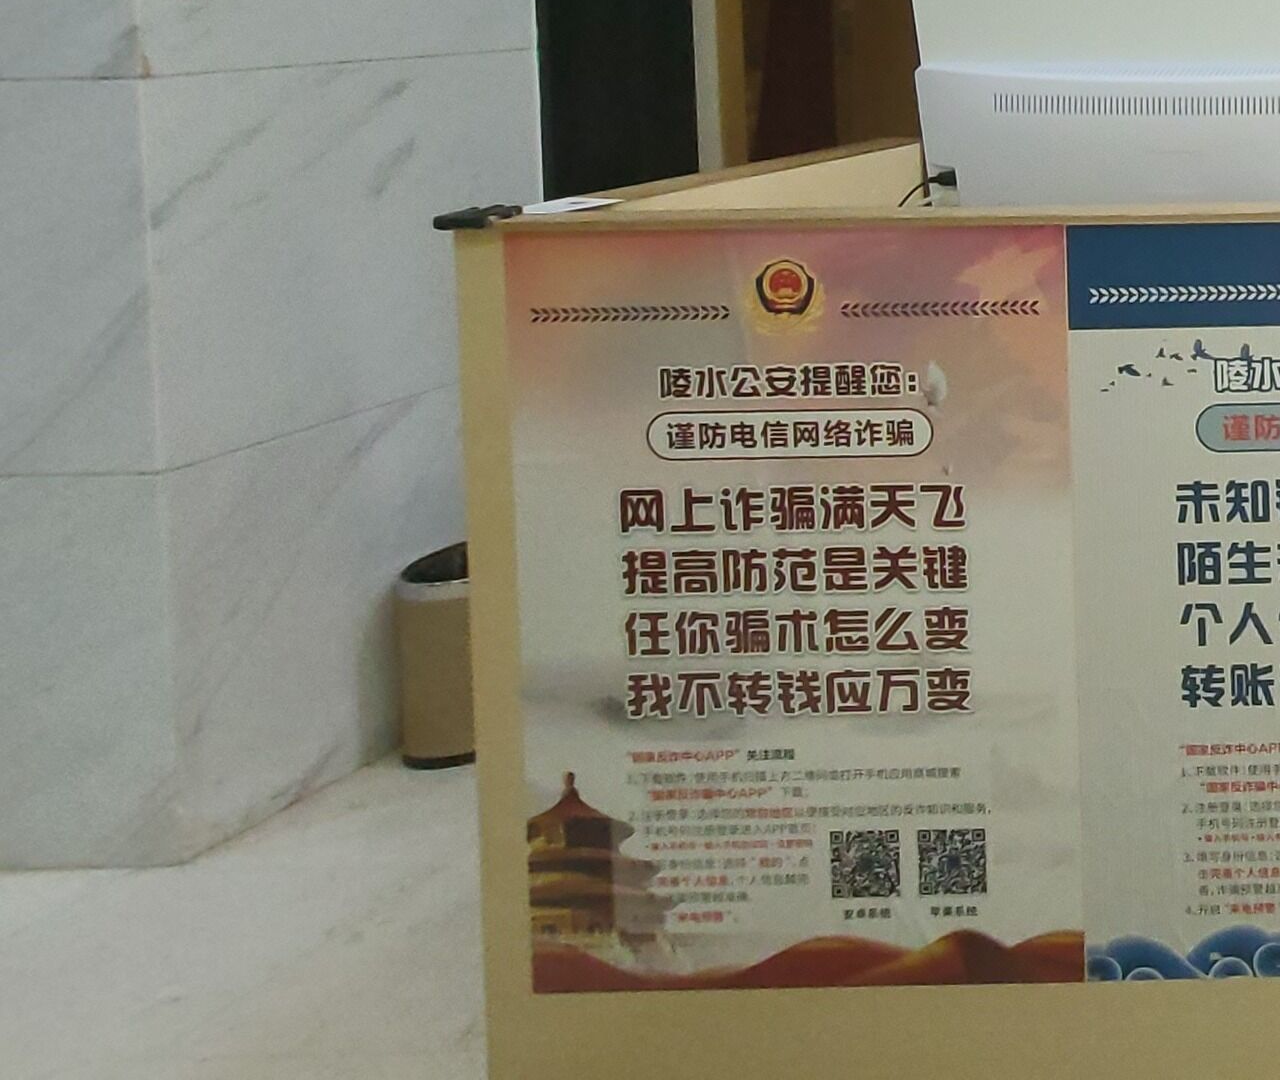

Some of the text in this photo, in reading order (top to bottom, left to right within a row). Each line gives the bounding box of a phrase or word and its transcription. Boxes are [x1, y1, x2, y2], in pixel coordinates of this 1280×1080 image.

[666, 418, 915, 450] 谨防电信网络诈骗
[619, 483, 967, 534] 网上诈骗满天飞
[621, 545, 969, 595] 提高防范是关键
[624, 606, 971, 657] 任你骗术怎么变
[627, 668, 973, 719] 我不转钱应万变
